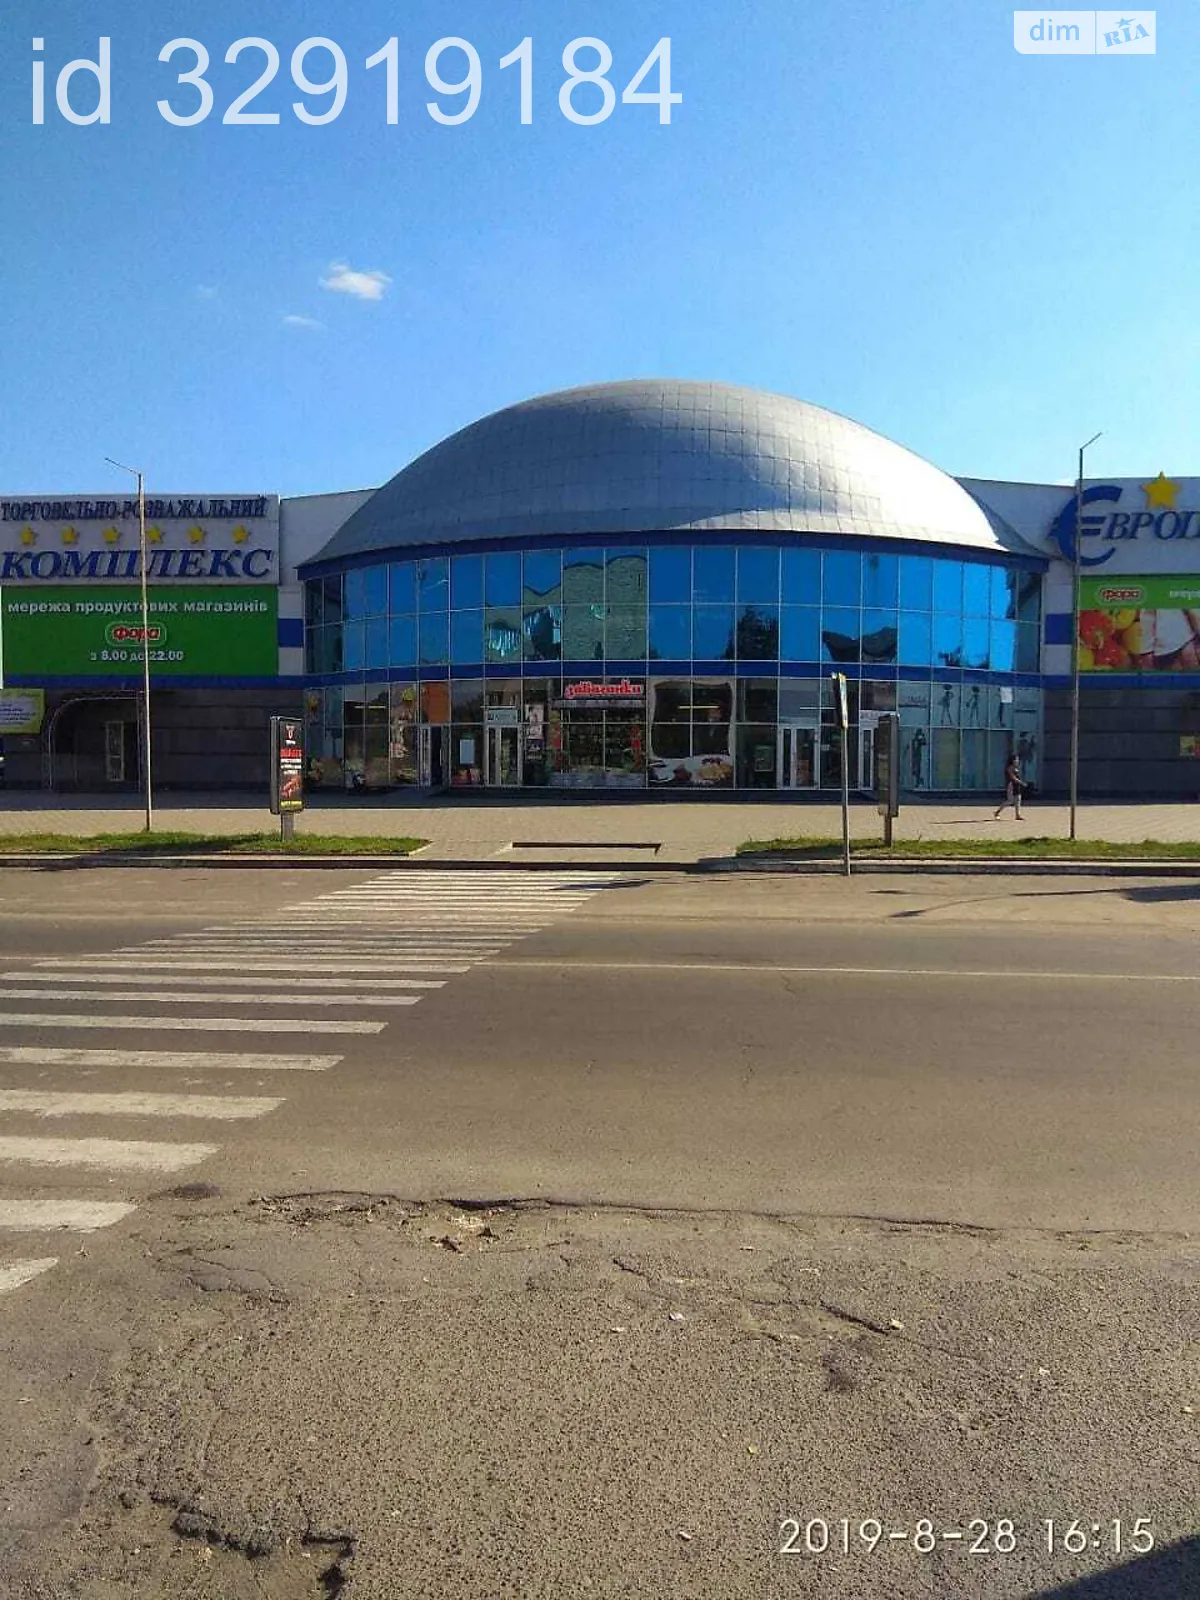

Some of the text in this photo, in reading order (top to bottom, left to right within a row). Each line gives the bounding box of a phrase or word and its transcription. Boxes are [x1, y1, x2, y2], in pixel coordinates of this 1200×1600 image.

[1, 549, 273, 579] КОМПЛЕКС
[8, 600, 268, 615] мережа продуктових магазинів
